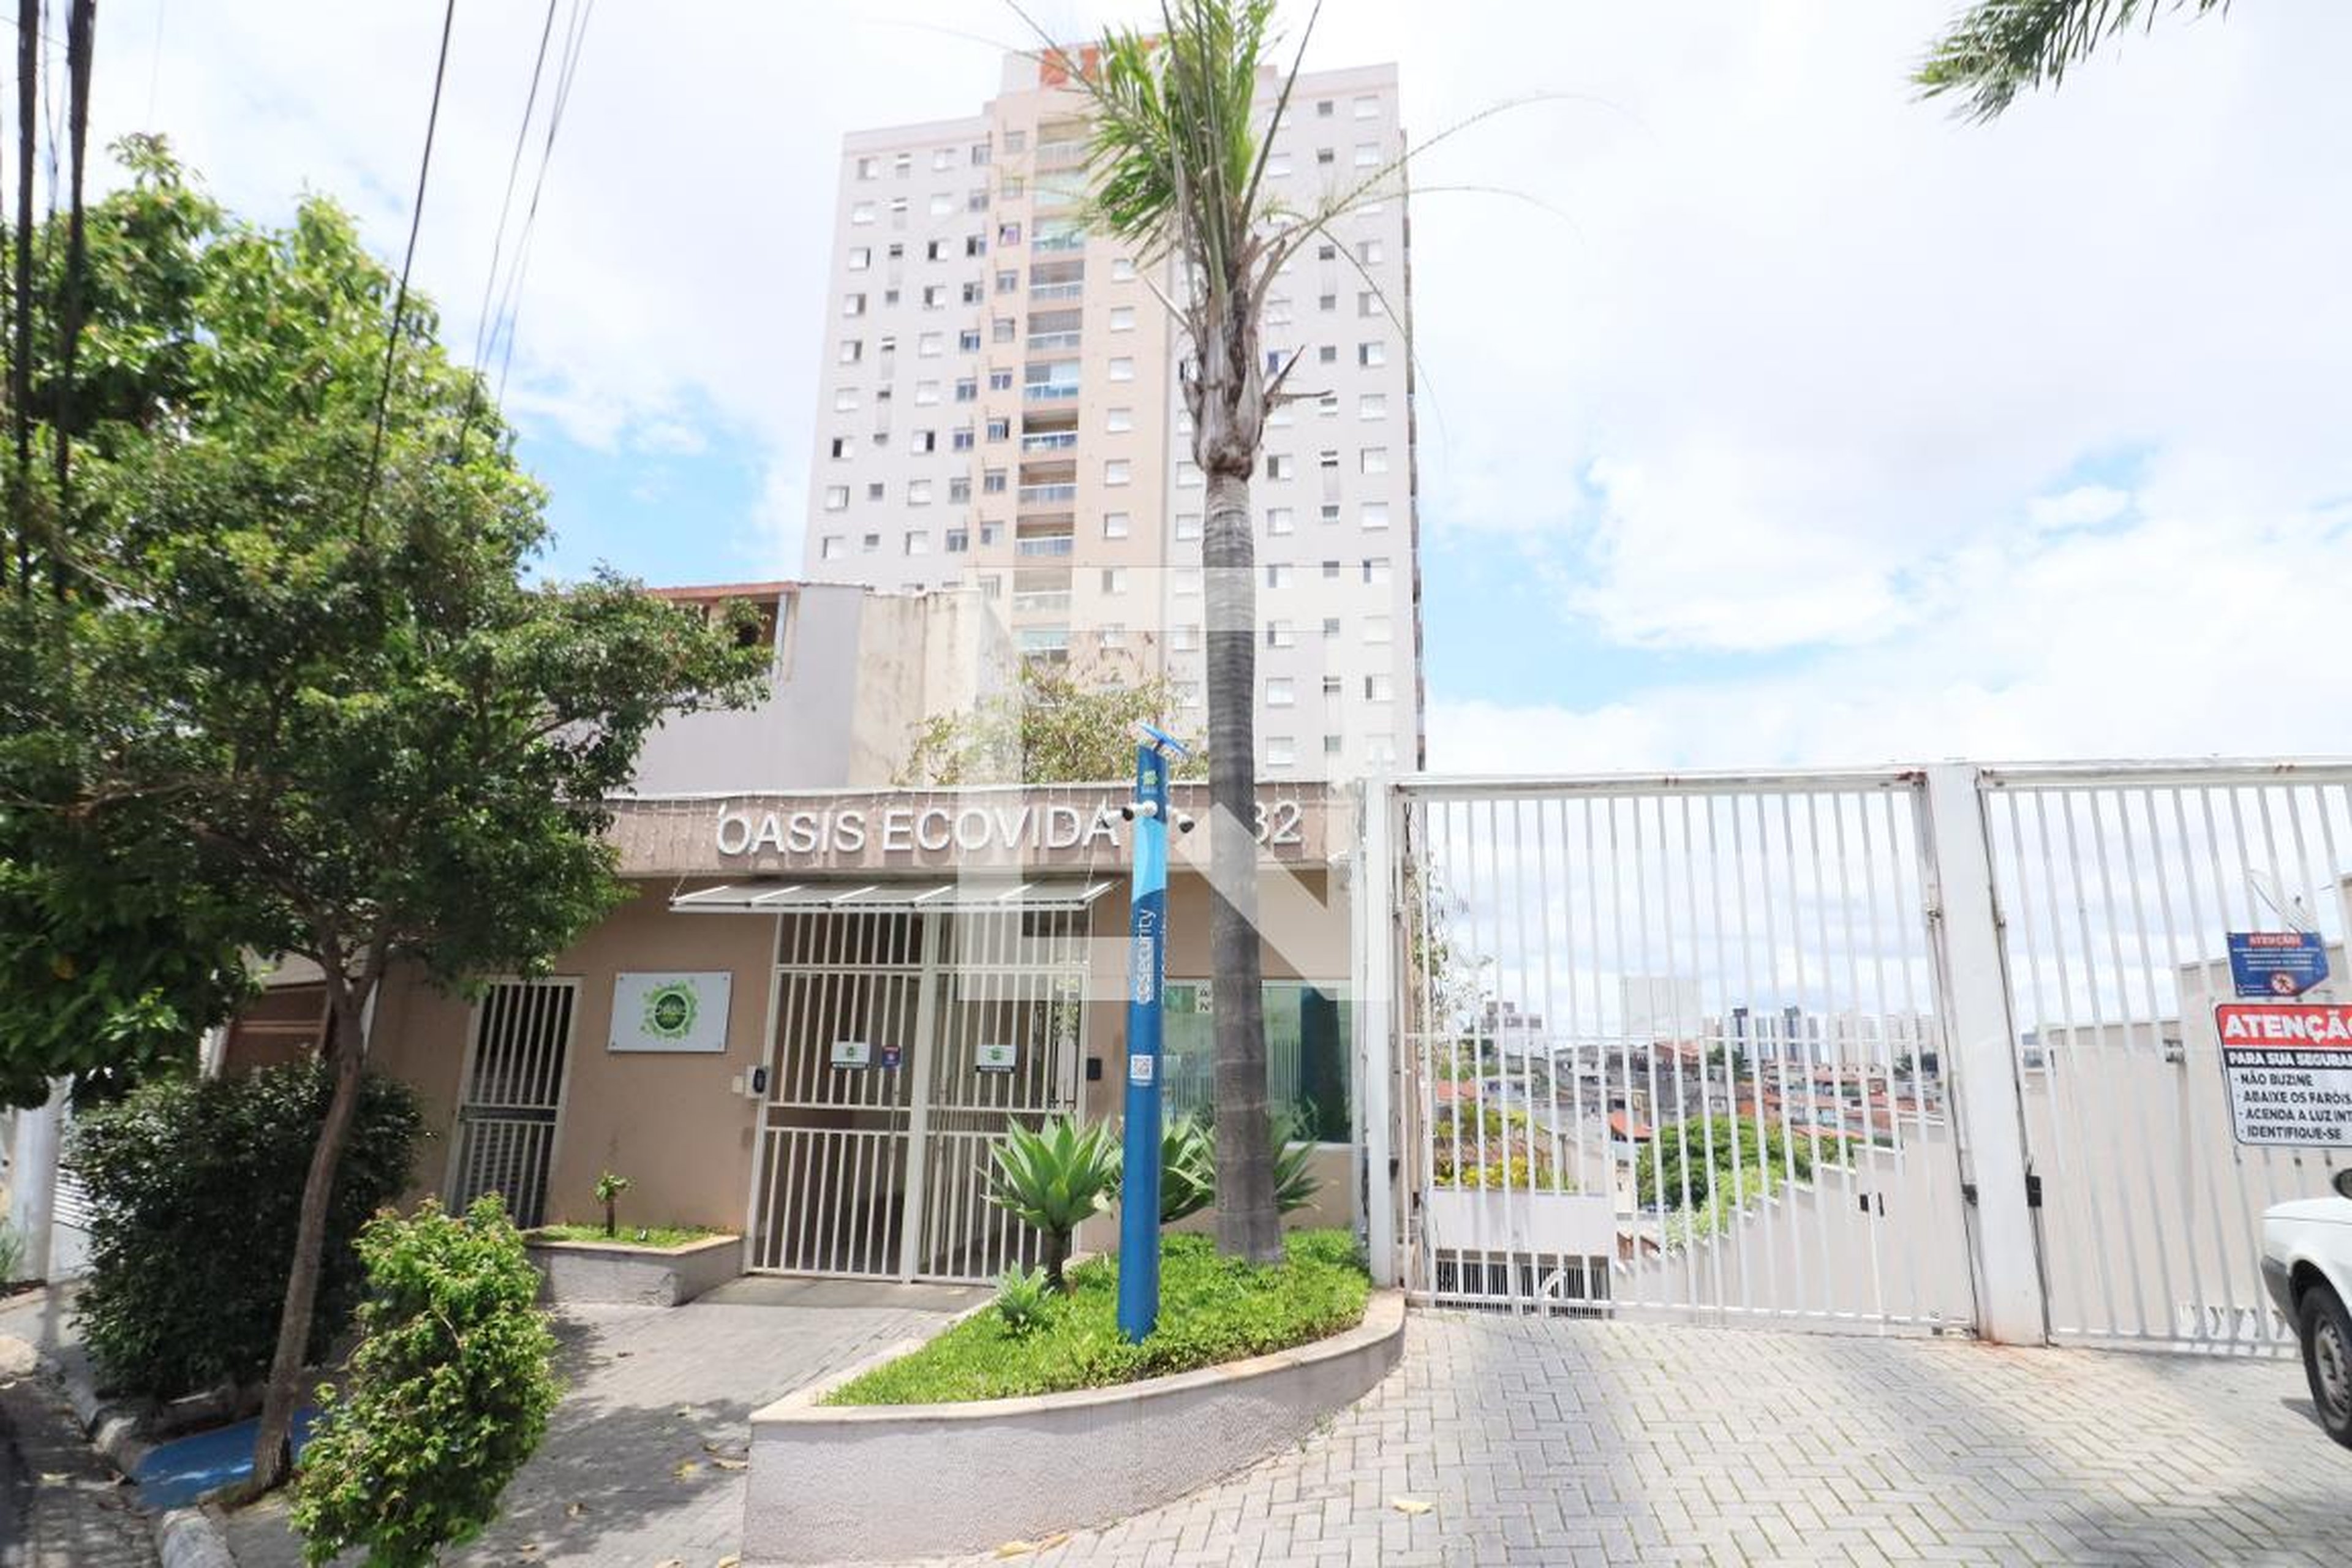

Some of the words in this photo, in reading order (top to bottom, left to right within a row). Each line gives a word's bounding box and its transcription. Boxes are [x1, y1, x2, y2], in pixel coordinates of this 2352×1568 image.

[884, 802, 1120, 850] ECOVIDA
[2228, 1051, 2266, 1065] PARA
[2266, 1052, 2296, 1066] SUA
[2270, 1073, 2314, 1087] BUZINE
[2244, 1090, 2288, 1103] ABAIXE
[2290, 1091, 2307, 1104] OS
[2245, 1107, 2296, 1121] ACENDA
[2299, 1109, 2307, 1121] A
[2309, 1109, 2333, 1122] LUZ
